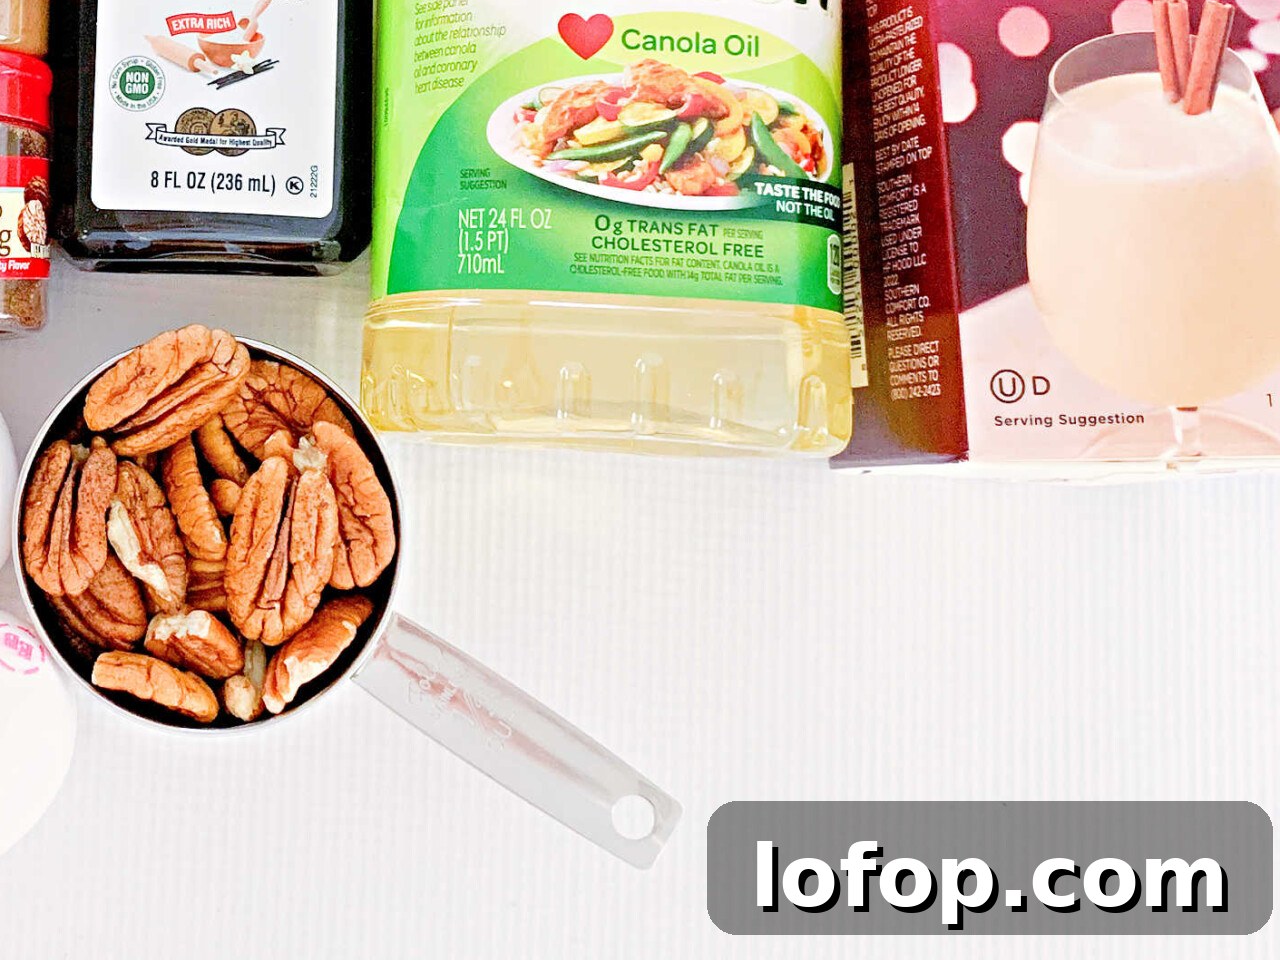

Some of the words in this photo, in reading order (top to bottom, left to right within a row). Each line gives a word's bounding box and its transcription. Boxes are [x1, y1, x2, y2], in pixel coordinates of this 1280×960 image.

[170, 17, 205, 33] EXTRA
[206, 16, 232, 30] RICH
[620, 28, 717, 56] Canola
[723, 32, 761, 58] Oil
[125, 71, 150, 83] NON
[124, 82, 150, 95] GMO
[459, 167, 491, 179] SERVING
[150, 170, 159, 189] 8
[164, 170, 181, 189] FL
[186, 171, 206, 190] OZ
[210, 172, 243, 195] (236
[247, 174, 276, 197] mL)
[459, 178, 508, 191] SUGGESTION
[753, 181, 800, 198] TASTE
[800, 186, 824, 203] THE
[775, 199, 802, 215] NOT
[803, 203, 824, 218] THE
[457, 207, 485, 230] NET
[488, 208, 508, 229] 24
[509, 208, 526, 229] FL
[529, 207, 553, 230] OZ
[458, 229, 484, 254] (1.5
[486, 227, 510, 255] PT)
[590, 235, 718, 256] CHOLESTEROL
[722, 242, 765, 259] FREE
[457, 252, 506, 276] 710mL
[912, 340, 940, 356] DIRECT
[927, 369, 939, 382] TO
[994, 414, 1054, 428] Serving
[1058, 412, 1145, 428] Suggestion
